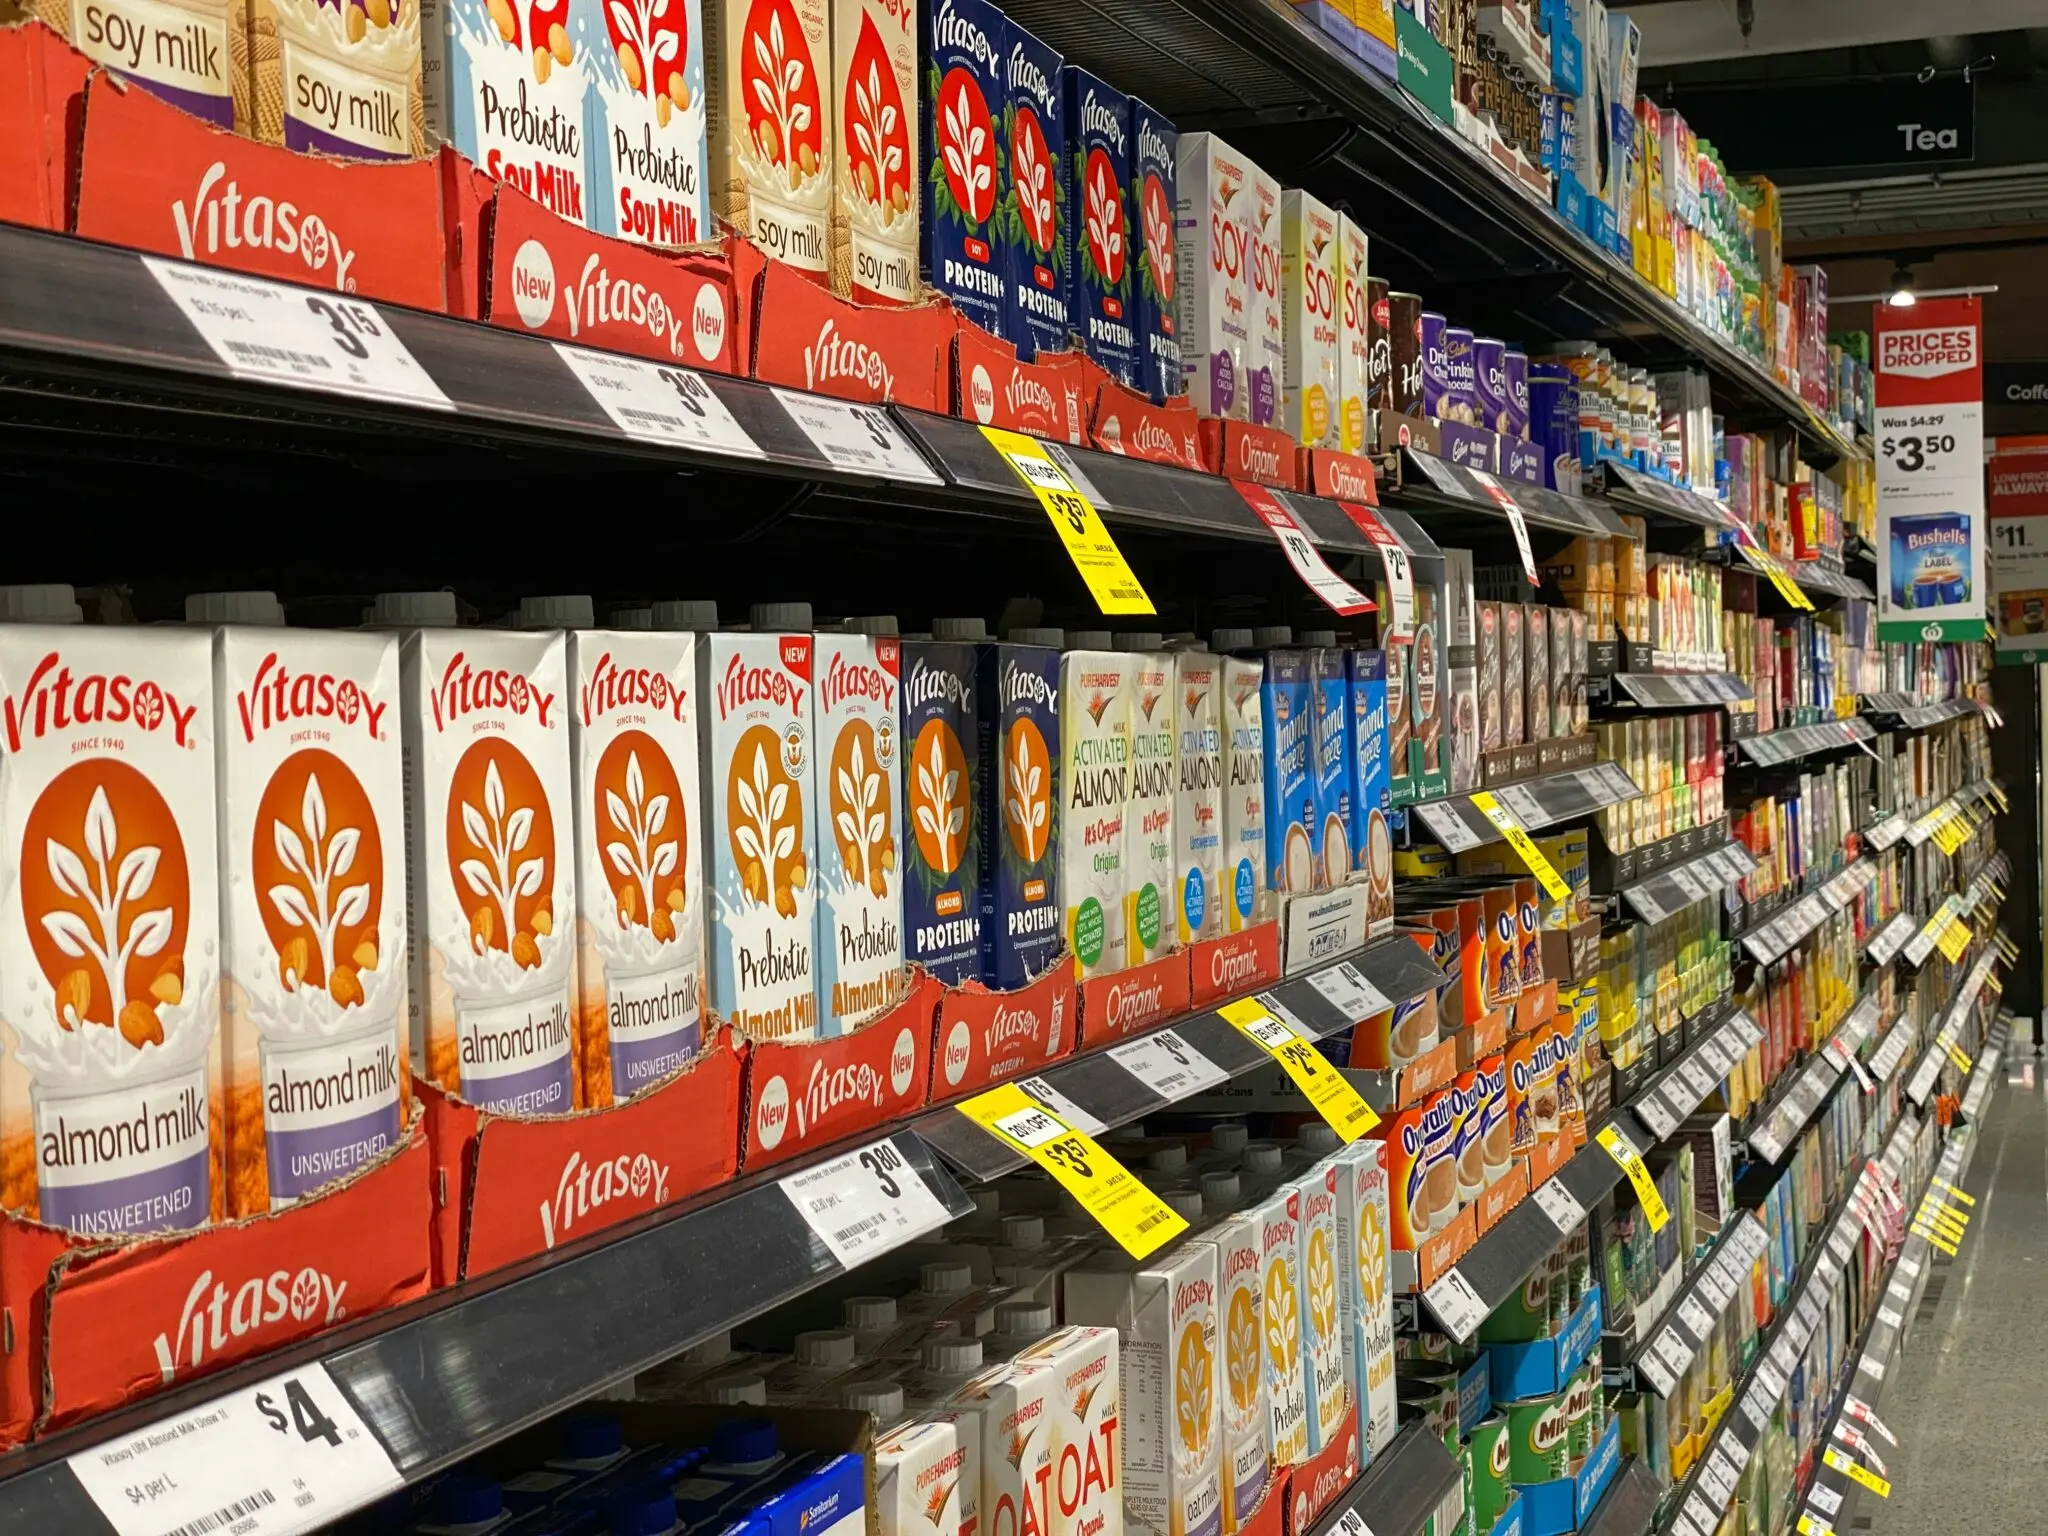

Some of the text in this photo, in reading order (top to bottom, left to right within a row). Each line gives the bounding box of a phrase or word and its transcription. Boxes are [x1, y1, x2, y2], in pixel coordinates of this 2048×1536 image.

[86, 6, 221, 79] soy milk
[1007, 42, 1055, 120] Vitasoy
[297, 73, 402, 140] soy milk
[480, 78, 580, 158] Prebiotic
[1081, 89, 1125, 157] Vitasoy
[614, 122, 696, 195] Prebiotic
[1139, 118, 1174, 182] Vitasoy
[1897, 124, 1958, 151] Tea
[535, 160, 583, 221] Milk
[172, 161, 355, 293] Vitasoy
[621, 186, 697, 244] Soy Milk
[758, 218, 824, 261] soy milk
[1212, 213, 1248, 284] SOY
[858, 252, 912, 291] soy milk
[945, 259, 1004, 298] PROTEIN+
[1253, 236, 1280, 303] SOY
[516, 253, 721, 355] New Vitasoy New
[804, 319, 895, 402] Vitasoy
[1884, 331, 1971, 353] PRICES
[1884, 350, 1972, 368] DROPPED
[973, 366, 1058, 424] New Vitasoy
[1882, 415, 1945, 428] Was $4.29
[1241, 434, 1280, 481] Organic
[1330, 461, 1367, 500] Organic
[1908, 528, 1967, 550] Bushells
[1996, 525, 2025, 546] $11
[1924, 558, 1951, 568] LABEL
[785, 647, 806, 663] NEW
[879, 647, 896, 662] NEW
[4, 651, 197, 753] Vitasoy
[236, 651, 387, 744] Vitasoy
[431, 651, 555, 733] Vitasoy
[582, 652, 687, 728] Vitasoy
[717, 653, 804, 721] Vitasoy
[821, 651, 894, 715] Vitasoy
[904, 656, 971, 716] Vitasoy
[1000, 659, 1058, 714] Vitasoy
[1081, 673, 1120, 688] PUREHARVEST
[71, 737, 124, 753] SINCE 1940
[290, 730, 330, 744] SINCE 1940
[1073, 737, 1127, 766] ACTIVATED
[1132, 733, 1172, 759] ACTIVATED
[1180, 730, 1220, 753] ACTIVATED
[1072, 766, 1128, 809] ALMOND
[1132, 762, 1173, 799] ALMOND
[1180, 756, 1221, 791] ALMOND
[1094, 851, 1119, 875] Original
[840, 907, 899, 966] Prebiotic
[916, 918, 981, 953] PROTEIN+
[1008, 905, 1059, 937] PROTEIN+
[1078, 929, 1102, 946] ACTIVATED
[738, 927, 810, 993] Prebiotic
[1212, 940, 1257, 992] Organic
[611, 972, 698, 1029] almond milk
[832, 976, 884, 1019] Almond
[1107, 974, 1163, 1032] Organic
[462, 1001, 569, 1064] almond milk
[946, 1003, 1040, 1067] New Vitasoy
[267, 1045, 397, 1115] almond milk
[627, 1046, 692, 1080] UNSWEETENED
[760, 1052, 912, 1139] New Vitasoy New
[1229, 1086, 1253, 1096] Cans
[42, 1086, 206, 1167] almond milk
[1008, 1114, 1051, 1138] 20% OFF
[291, 1132, 388, 1177] UNSWEETENED
[71, 1186, 192, 1234] UNSWEETENED
[539, 1151, 669, 1249] Vitasoy
[1222, 1247, 1260, 1295] Vitasoy
[153, 1267, 347, 1384] Vitasoy
[1172, 1279, 1213, 1330] Vitasoy
[1366, 1322, 1390, 1361] Prebiotic
[1066, 1355, 1107, 1391] PUREHARVEST
[1317, 1352, 1341, 1396] Prebiotic
[255, 1378, 343, 1447] $4
[999, 1397, 1043, 1435] PUREHARVEST
[1101, 1402, 1118, 1420] MILK
[1274, 1389, 1304, 1435] Prebiotic
[100, 1448, 133, 1466] Vitasoy
[131, 1438, 149, 1453] Uht
[148, 1427, 179, 1448] Almond
[177, 1420, 197, 1435] Milk
[1237, 1433, 1264, 1475] oat milk
[125, 1472, 178, 1506] $4 per L
[916, 1446, 967, 1491] PUREHARVEST
[1058, 1417, 1117, 1517] OAT
[809, 1492, 839, 1518] Sanitarium
[993, 1464, 1052, 1536] OAT
[1188, 1475, 1218, 1521] oat milk
